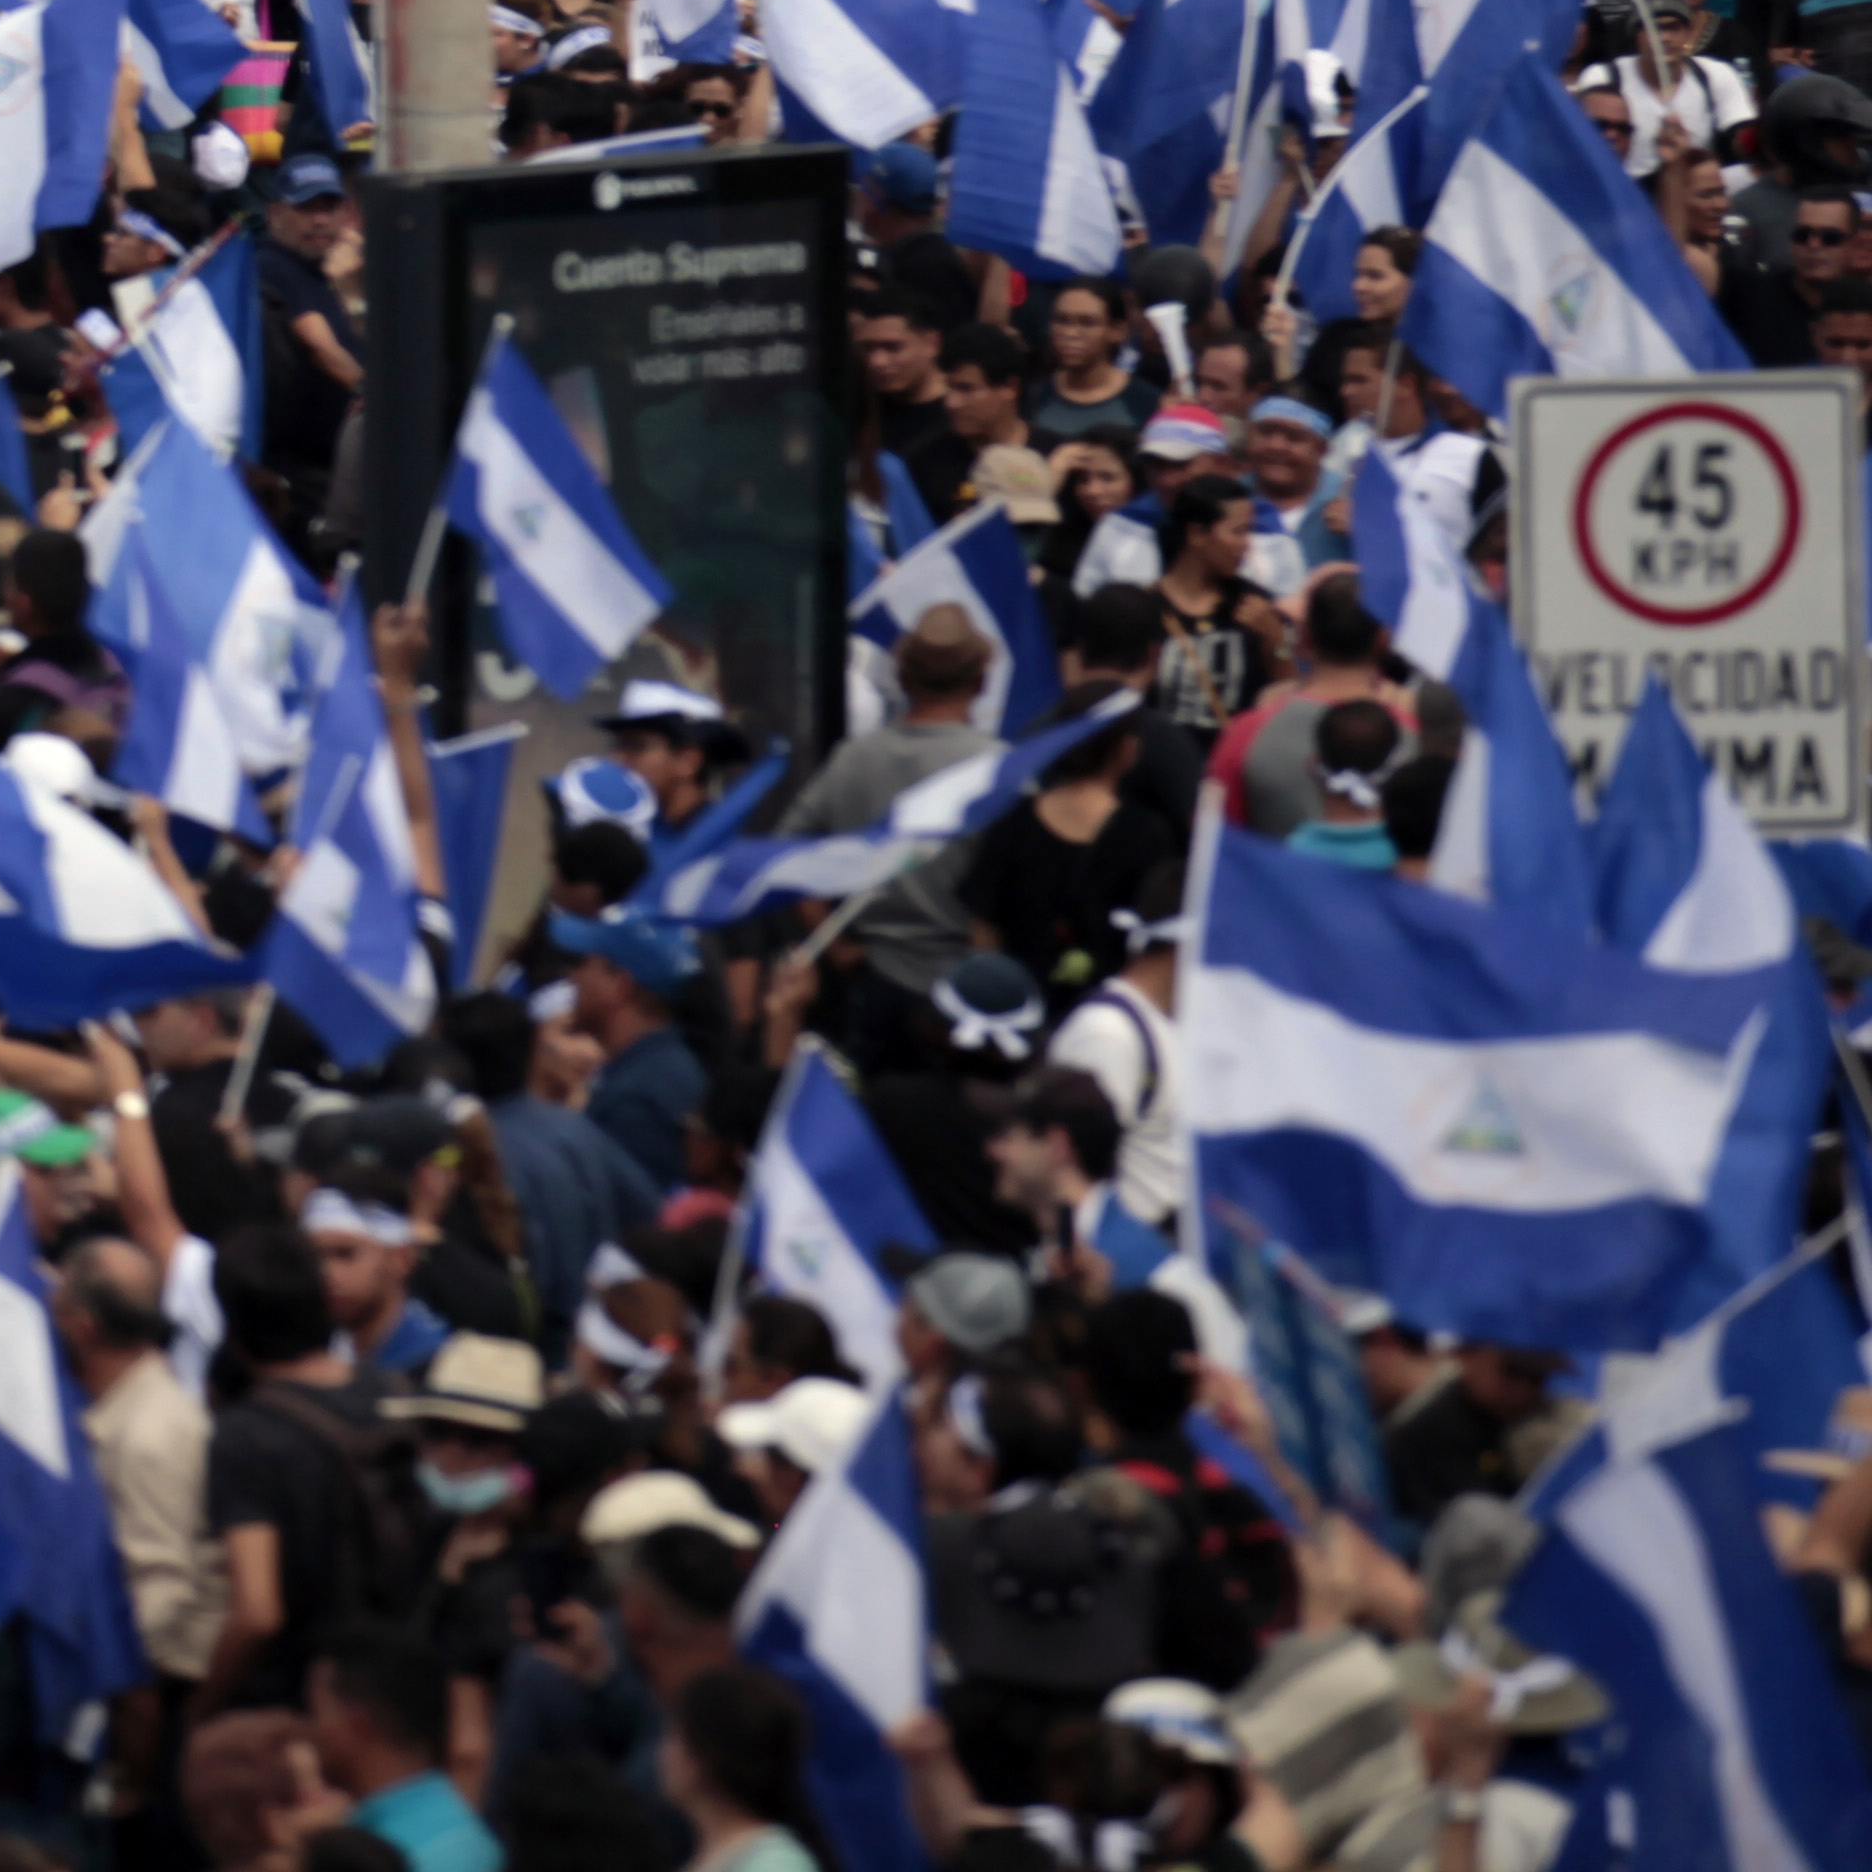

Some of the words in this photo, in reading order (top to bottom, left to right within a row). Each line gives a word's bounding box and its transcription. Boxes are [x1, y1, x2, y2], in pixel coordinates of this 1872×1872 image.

[552, 249, 664, 294] Cuenta
[665, 240, 808, 288] Suprema
[1632, 444, 1733, 532] 45
[1630, 540, 1738, 588] KPH
[1558, 738, 1834, 811] MIMA
